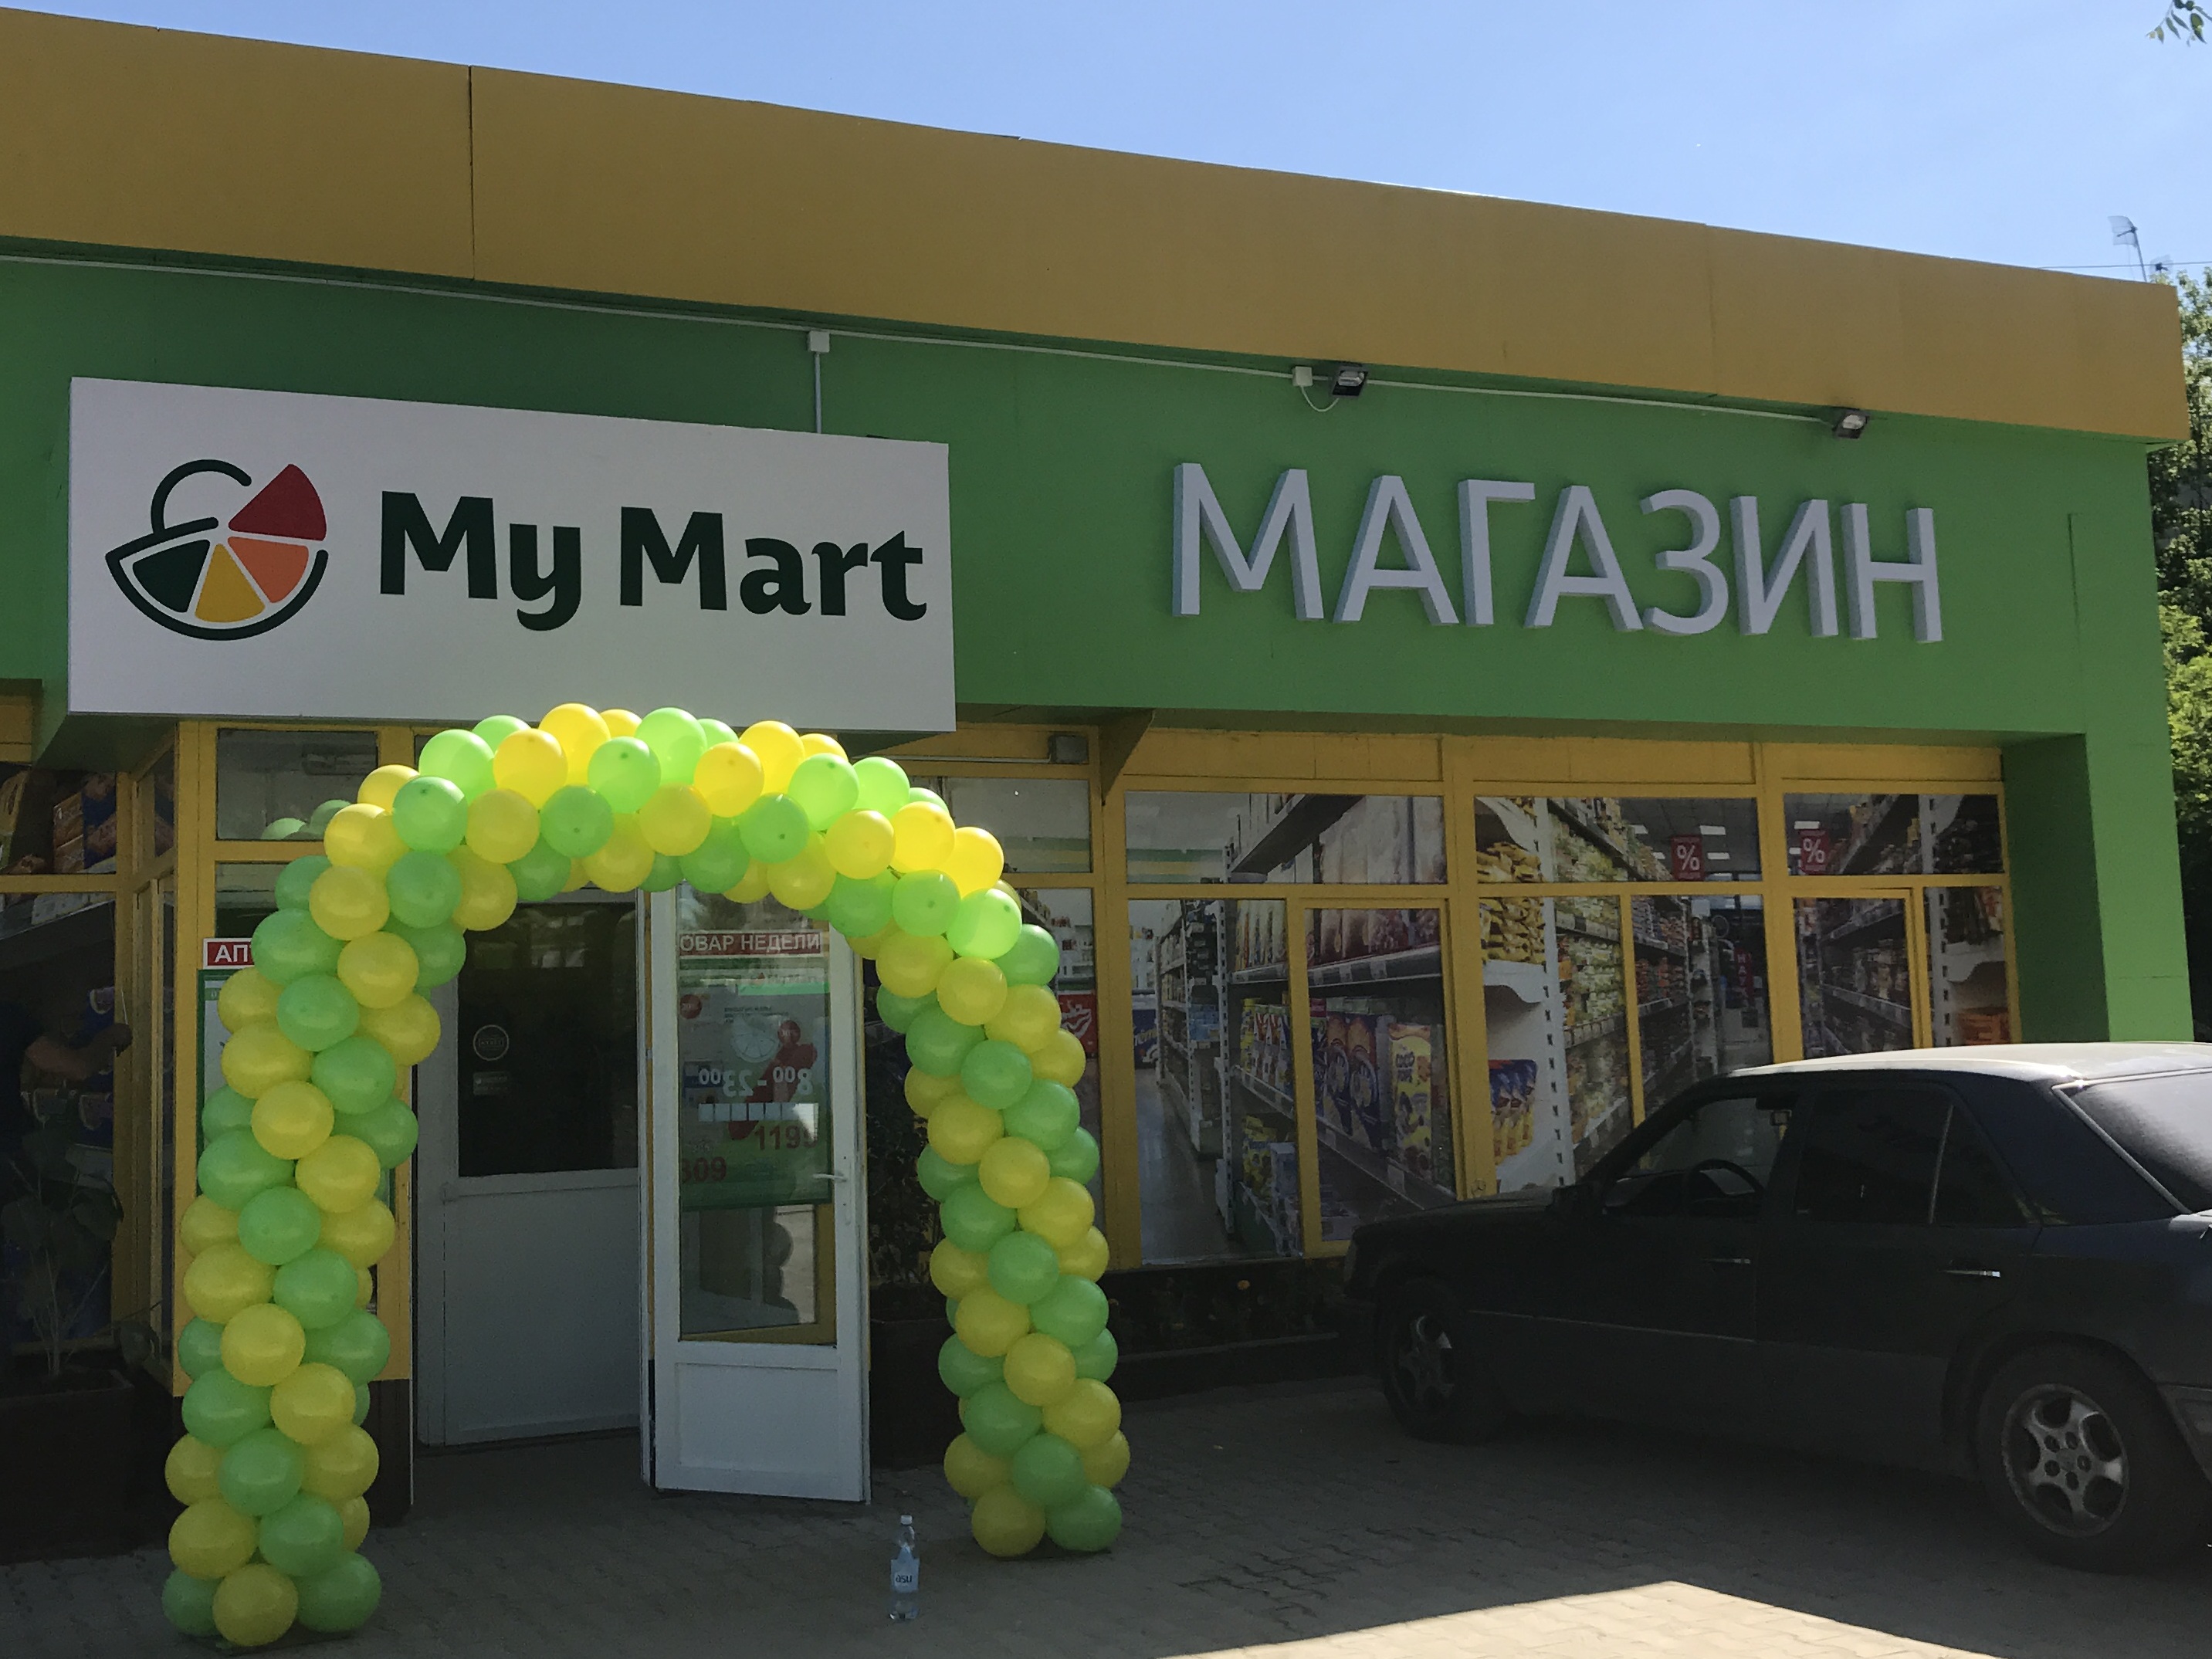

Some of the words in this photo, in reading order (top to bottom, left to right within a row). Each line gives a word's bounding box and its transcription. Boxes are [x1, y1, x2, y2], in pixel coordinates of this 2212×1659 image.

[380, 490, 581, 631] My
[620, 506, 927, 621] Mart
[1172, 462, 1943, 642] МАГАЗИН
[214, 944, 252, 963] АП
[679, 935, 734, 952] ОВАР
[740, 933, 820, 953] НЕДЕЛИ
